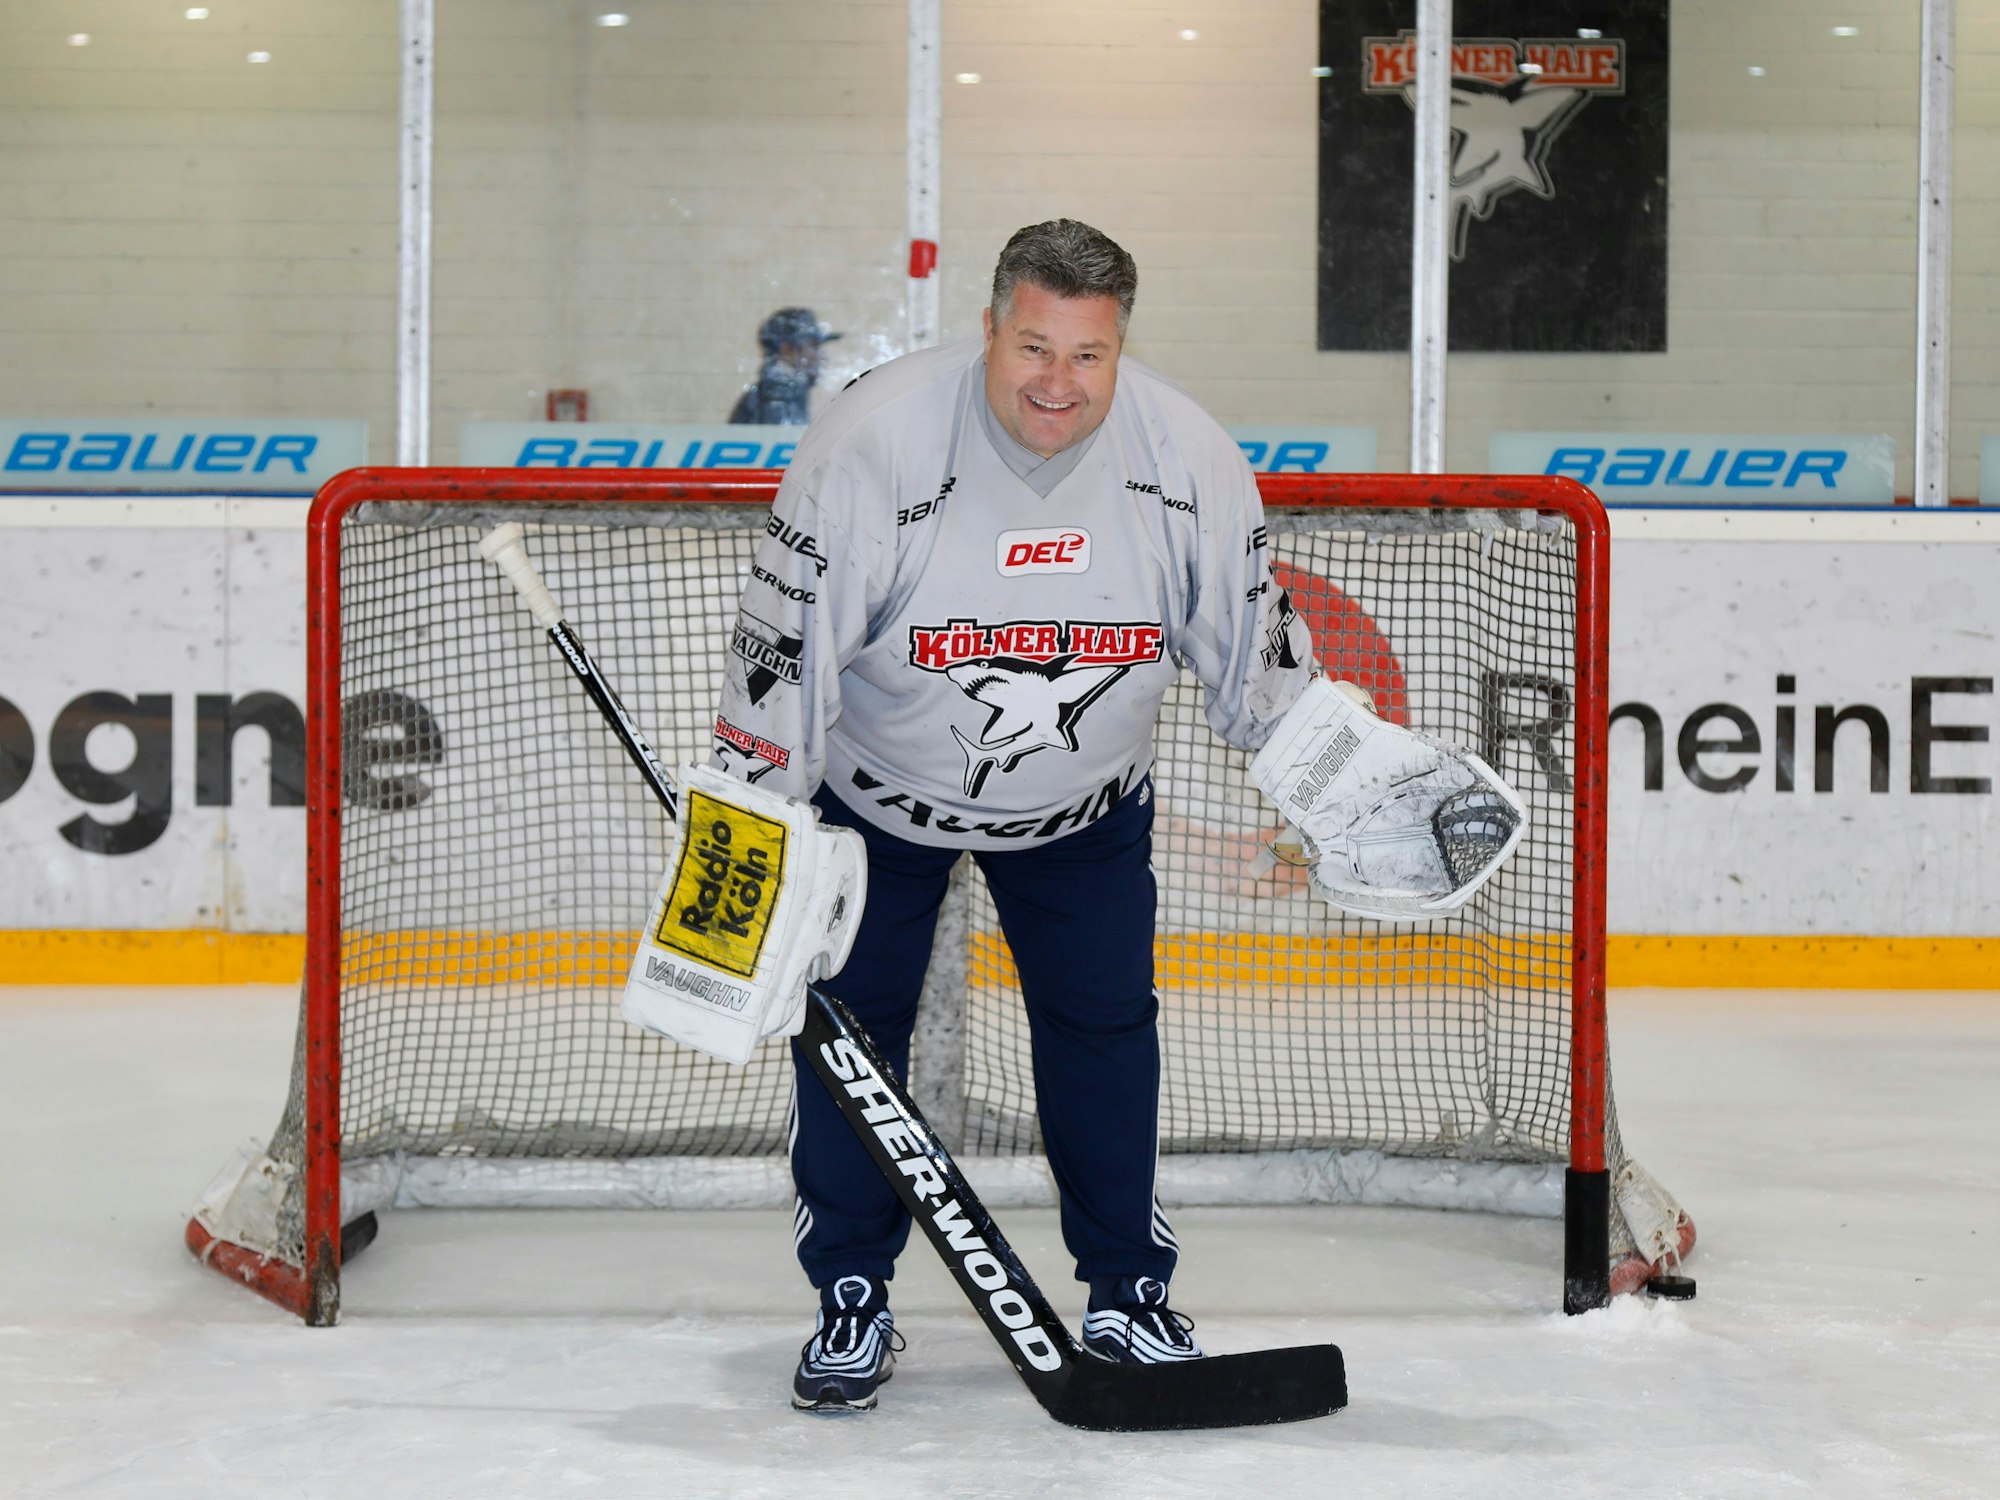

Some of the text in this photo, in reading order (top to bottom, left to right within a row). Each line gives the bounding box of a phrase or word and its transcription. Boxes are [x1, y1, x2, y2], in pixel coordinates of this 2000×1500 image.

[1370, 37, 1618, 85] KNER HAIE
[915, 625, 1161, 668] KÖLNER HAIE
[755, 738, 788, 769] HAIE
[1289, 724, 1362, 812] VAUGHN
[679, 820, 732, 936] Radio
[720, 847, 768, 938] Köln
[645, 957, 751, 1012] VAUGHN
[819, 1036, 1062, 1373] SHER-WOOD
